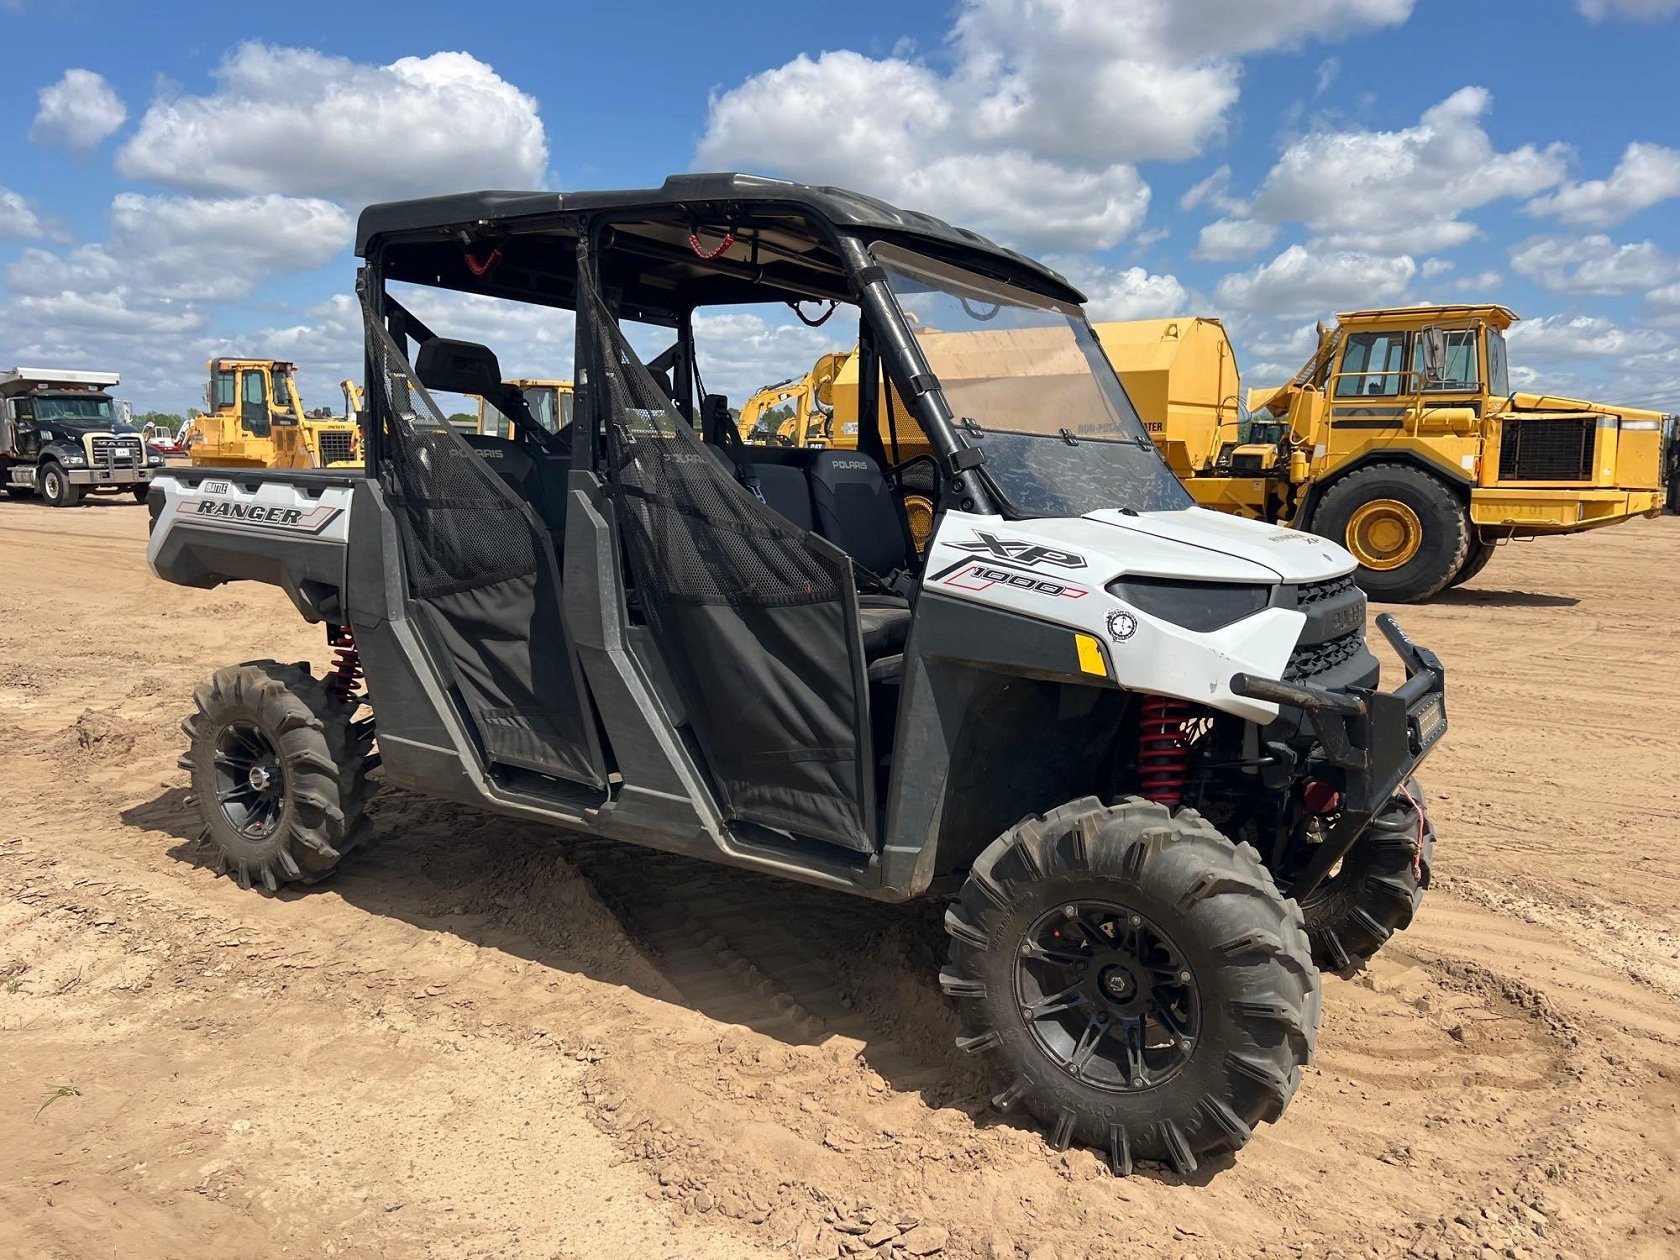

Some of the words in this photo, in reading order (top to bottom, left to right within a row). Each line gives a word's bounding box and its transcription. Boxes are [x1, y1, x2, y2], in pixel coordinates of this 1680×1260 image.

[1143, 422, 1163, 432] ATER
[831, 460, 868, 470] POLARIS
[196, 499, 303, 527] RANGER
[940, 528, 1089, 570] XP
[970, 565, 1066, 597] 1000
